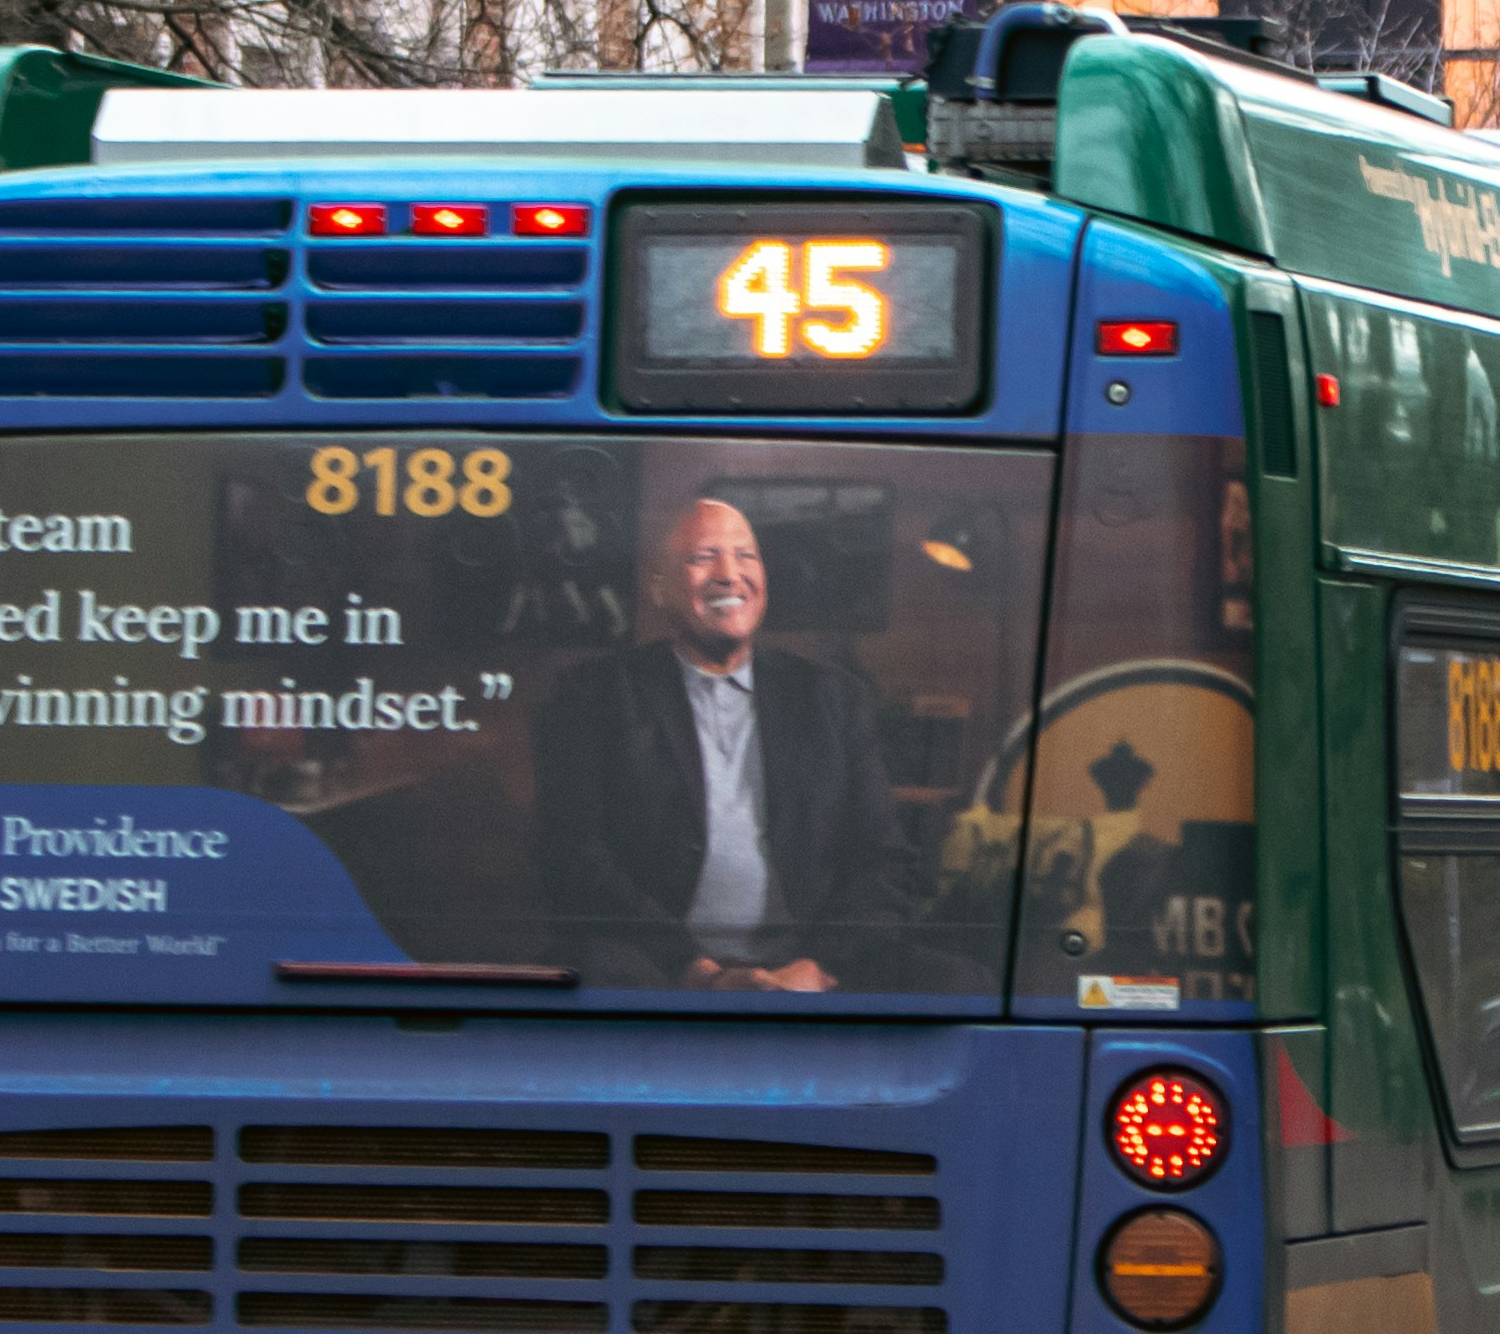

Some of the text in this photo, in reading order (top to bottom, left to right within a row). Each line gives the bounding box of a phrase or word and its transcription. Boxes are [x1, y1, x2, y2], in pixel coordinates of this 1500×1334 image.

[719, 239, 890, 358] 45
[306, 447, 512, 517] 8188
[77, 590, 219, 658] keep
[236, 605, 329, 644] me
[344, 594, 404, 644] in
[221, 673, 512, 731] mindset.”
[2, 814, 229, 859] Providence
[6, 930, 41, 952] for
[46, 938, 60, 953] a
[67, 933, 138, 955] Better
